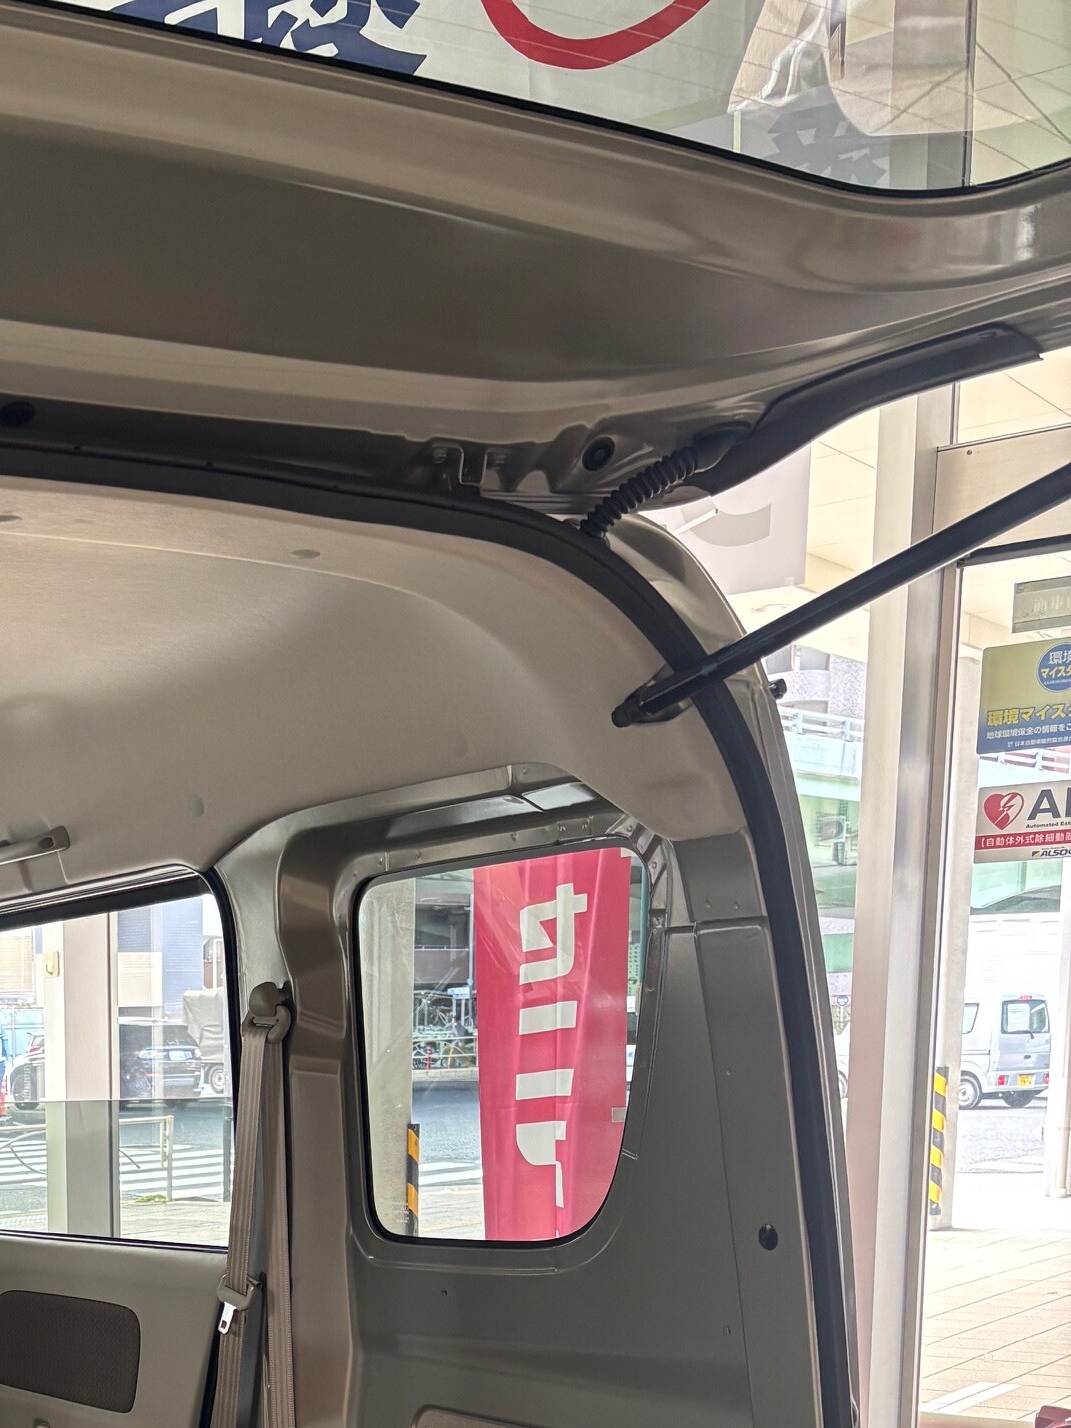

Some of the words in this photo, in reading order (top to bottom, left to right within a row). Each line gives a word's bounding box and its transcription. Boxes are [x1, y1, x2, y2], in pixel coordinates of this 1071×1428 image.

[987, 703, 1071, 726] 環境マイス
[1027, 787, 1071, 820] A
